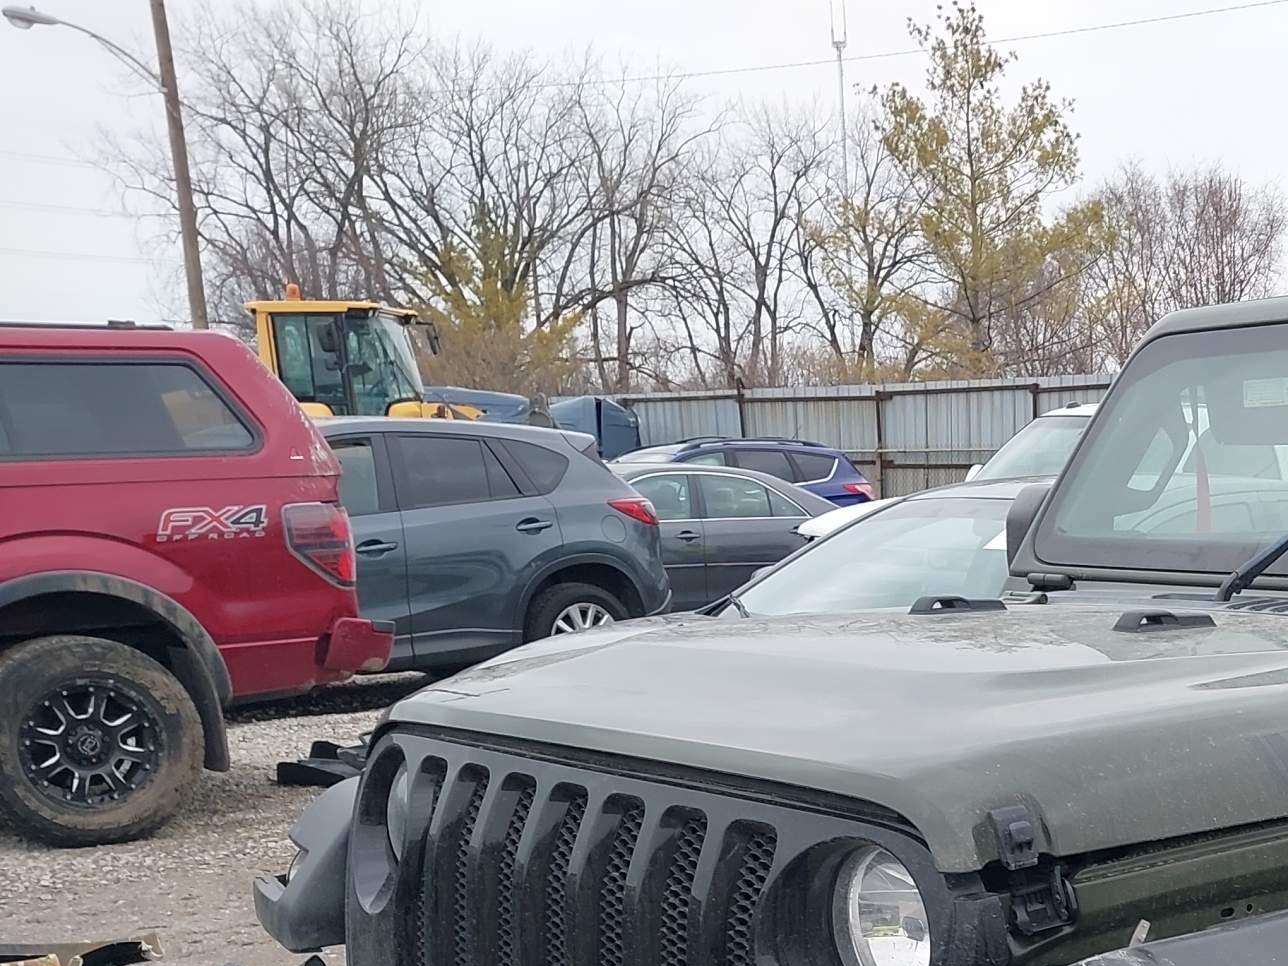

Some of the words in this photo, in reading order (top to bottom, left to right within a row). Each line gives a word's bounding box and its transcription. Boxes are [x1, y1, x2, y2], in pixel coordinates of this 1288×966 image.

[158, 504, 269, 535] FX4
[156, 533, 195, 542] OFF
[208, 531, 266, 540] ROAD
